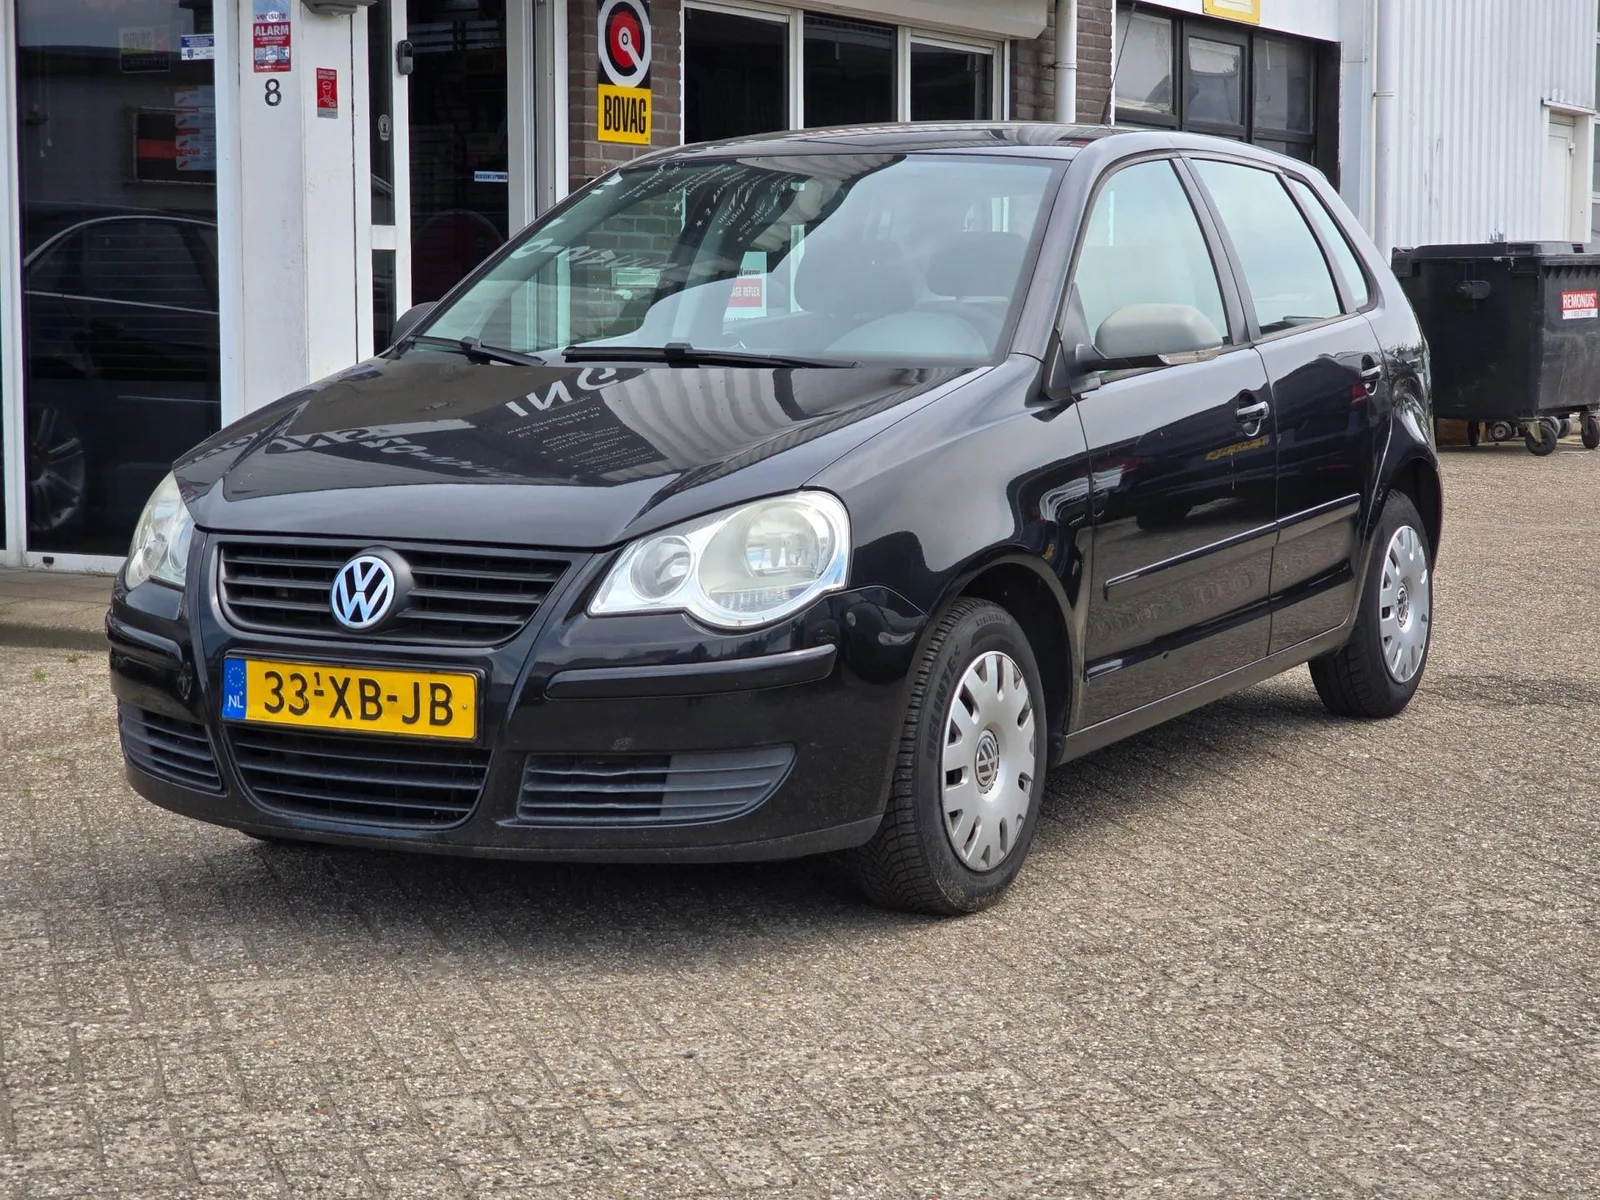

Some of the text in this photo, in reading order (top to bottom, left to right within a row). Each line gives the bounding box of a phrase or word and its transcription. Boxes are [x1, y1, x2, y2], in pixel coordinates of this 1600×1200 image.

[256, 11, 287, 20] verisure
[254, 24, 290, 37] ALARM
[264, 78, 282, 107] 8
[603, 95, 647, 135] BOVAG
[1562, 293, 1595, 309] REMONDIS
[228, 694, 244, 709] NL
[264, 670, 454, 727] 33-XB-JB
